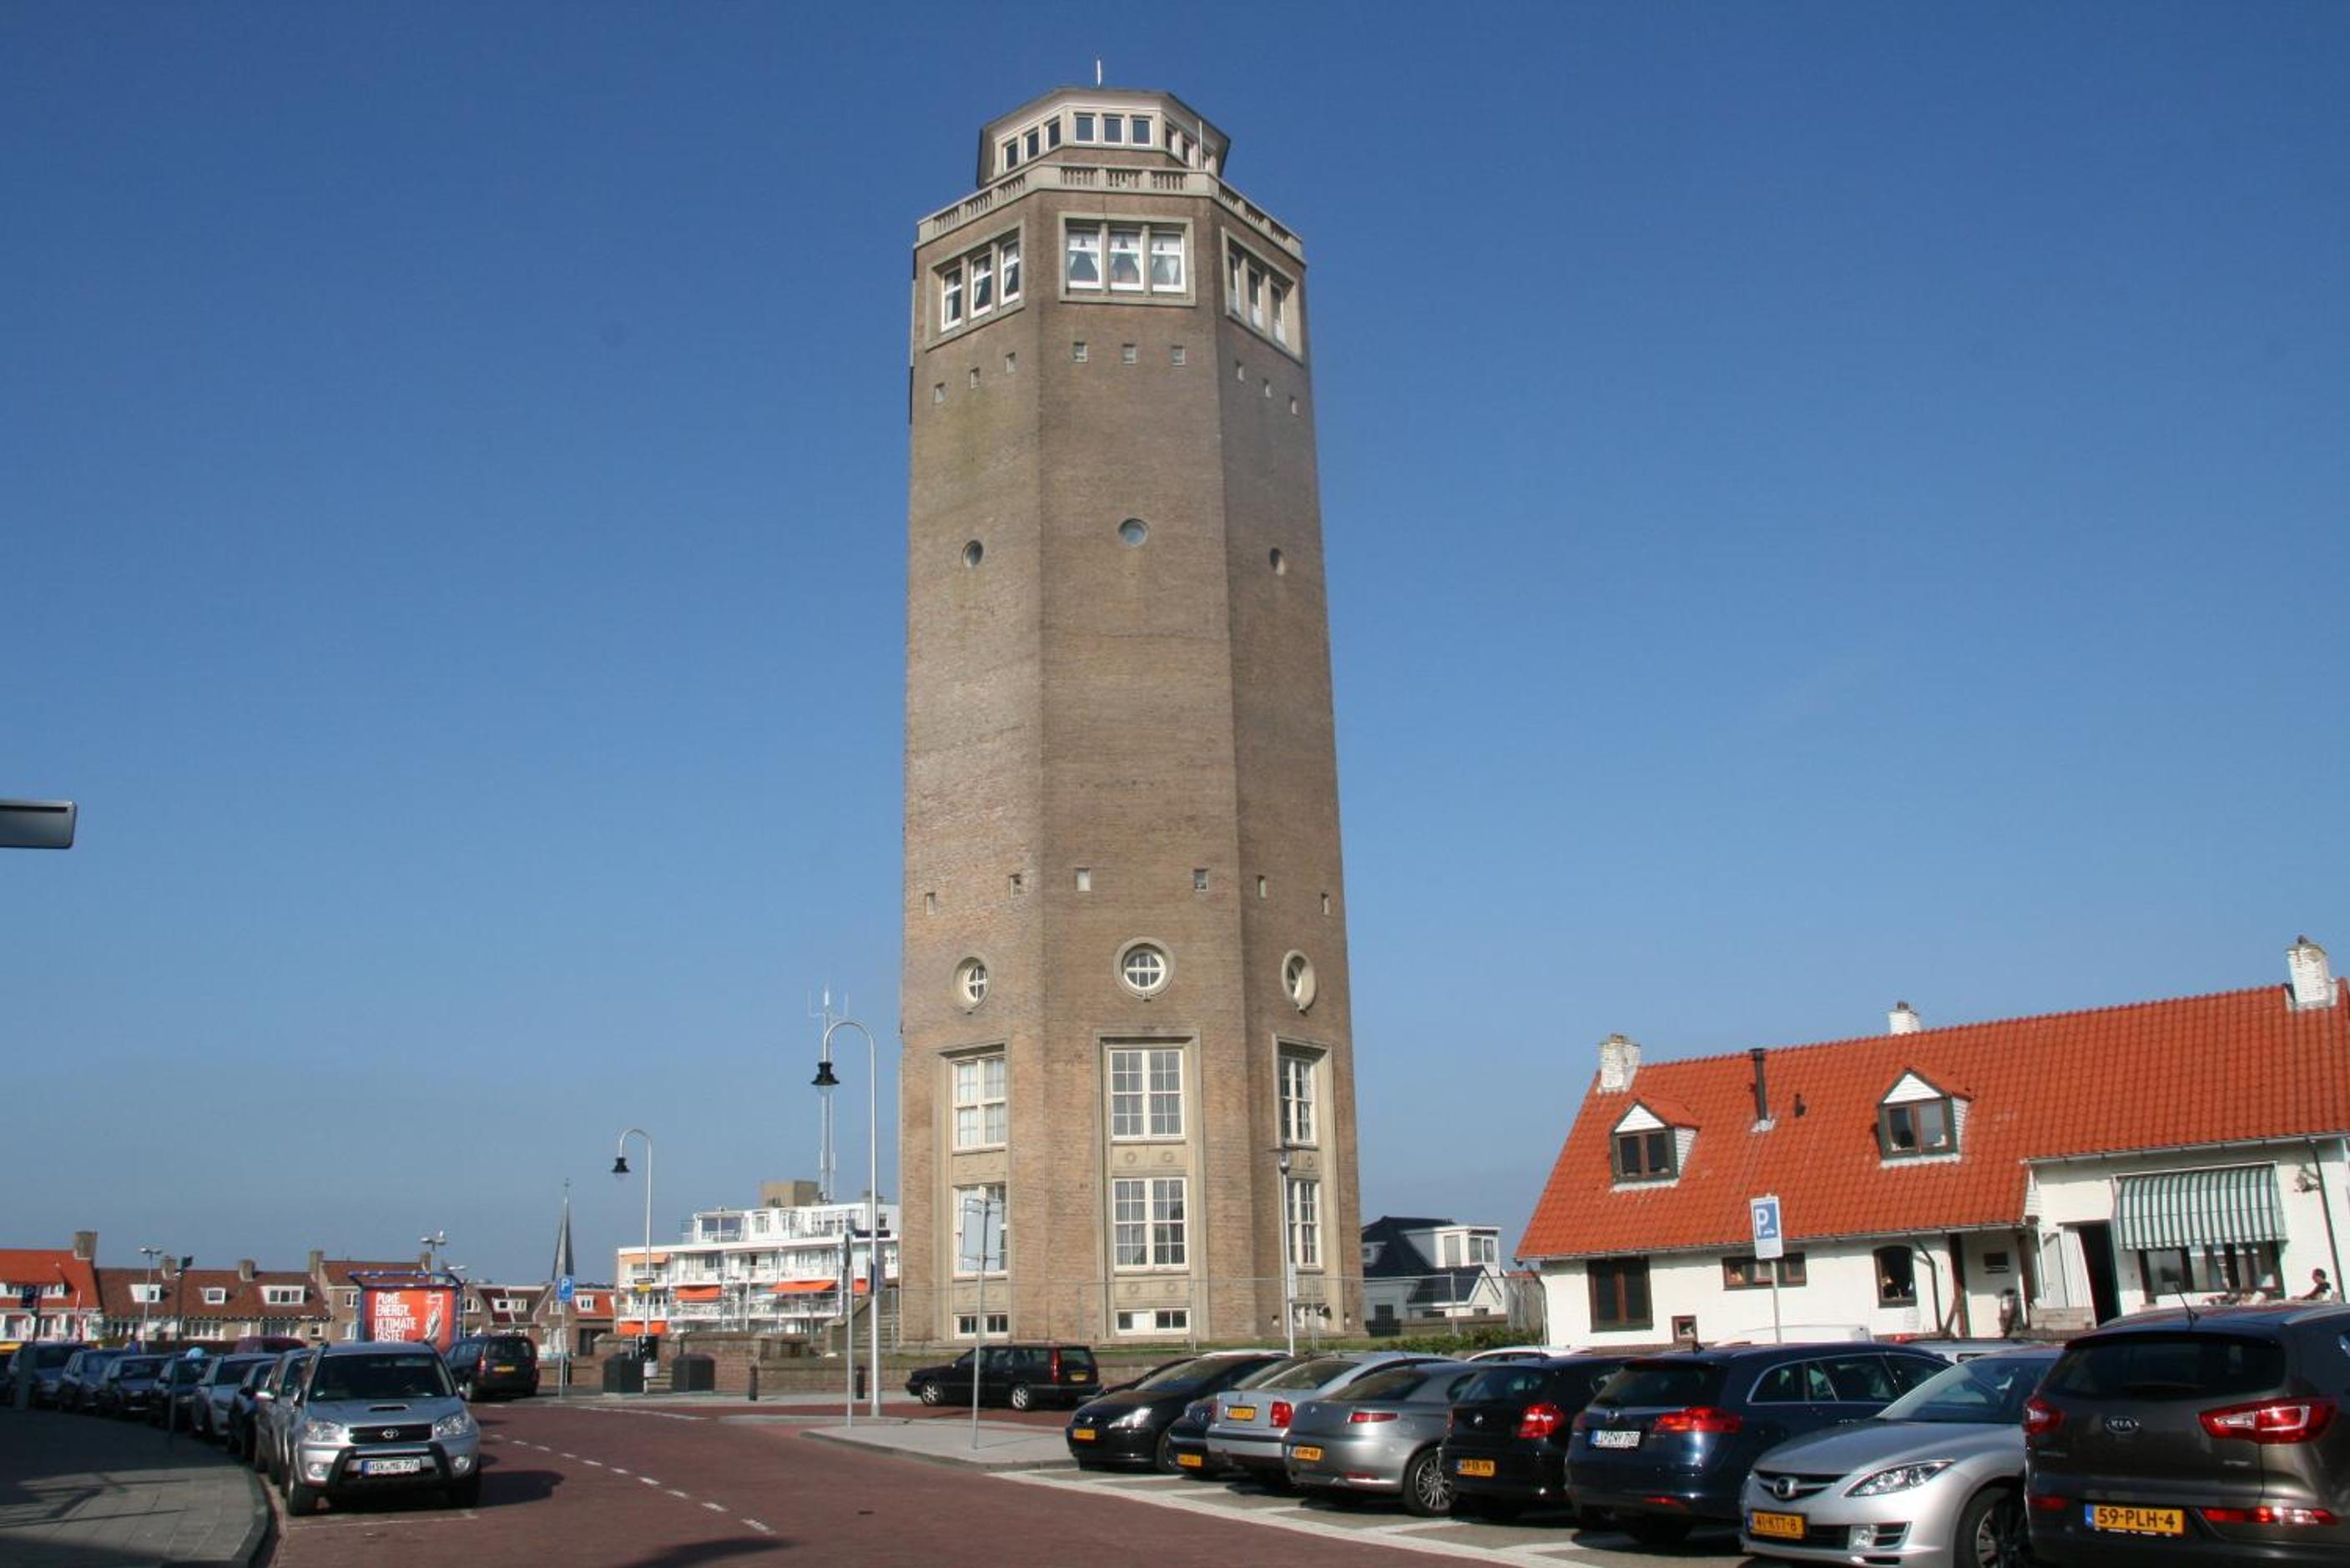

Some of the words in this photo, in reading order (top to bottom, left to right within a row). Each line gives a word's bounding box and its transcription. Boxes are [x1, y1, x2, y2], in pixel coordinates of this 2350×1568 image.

[1754, 1208, 1770, 1238] P
[561, 1277, 571, 1292] P
[376, 1292, 401, 1304] PURE
[374, 1317, 417, 1329] ULTIMATE
[374, 1329, 406, 1342] TASTE!
[2110, 1419, 2131, 1429] KIA
[2099, 1507, 2176, 1529] 59-PLH-4
